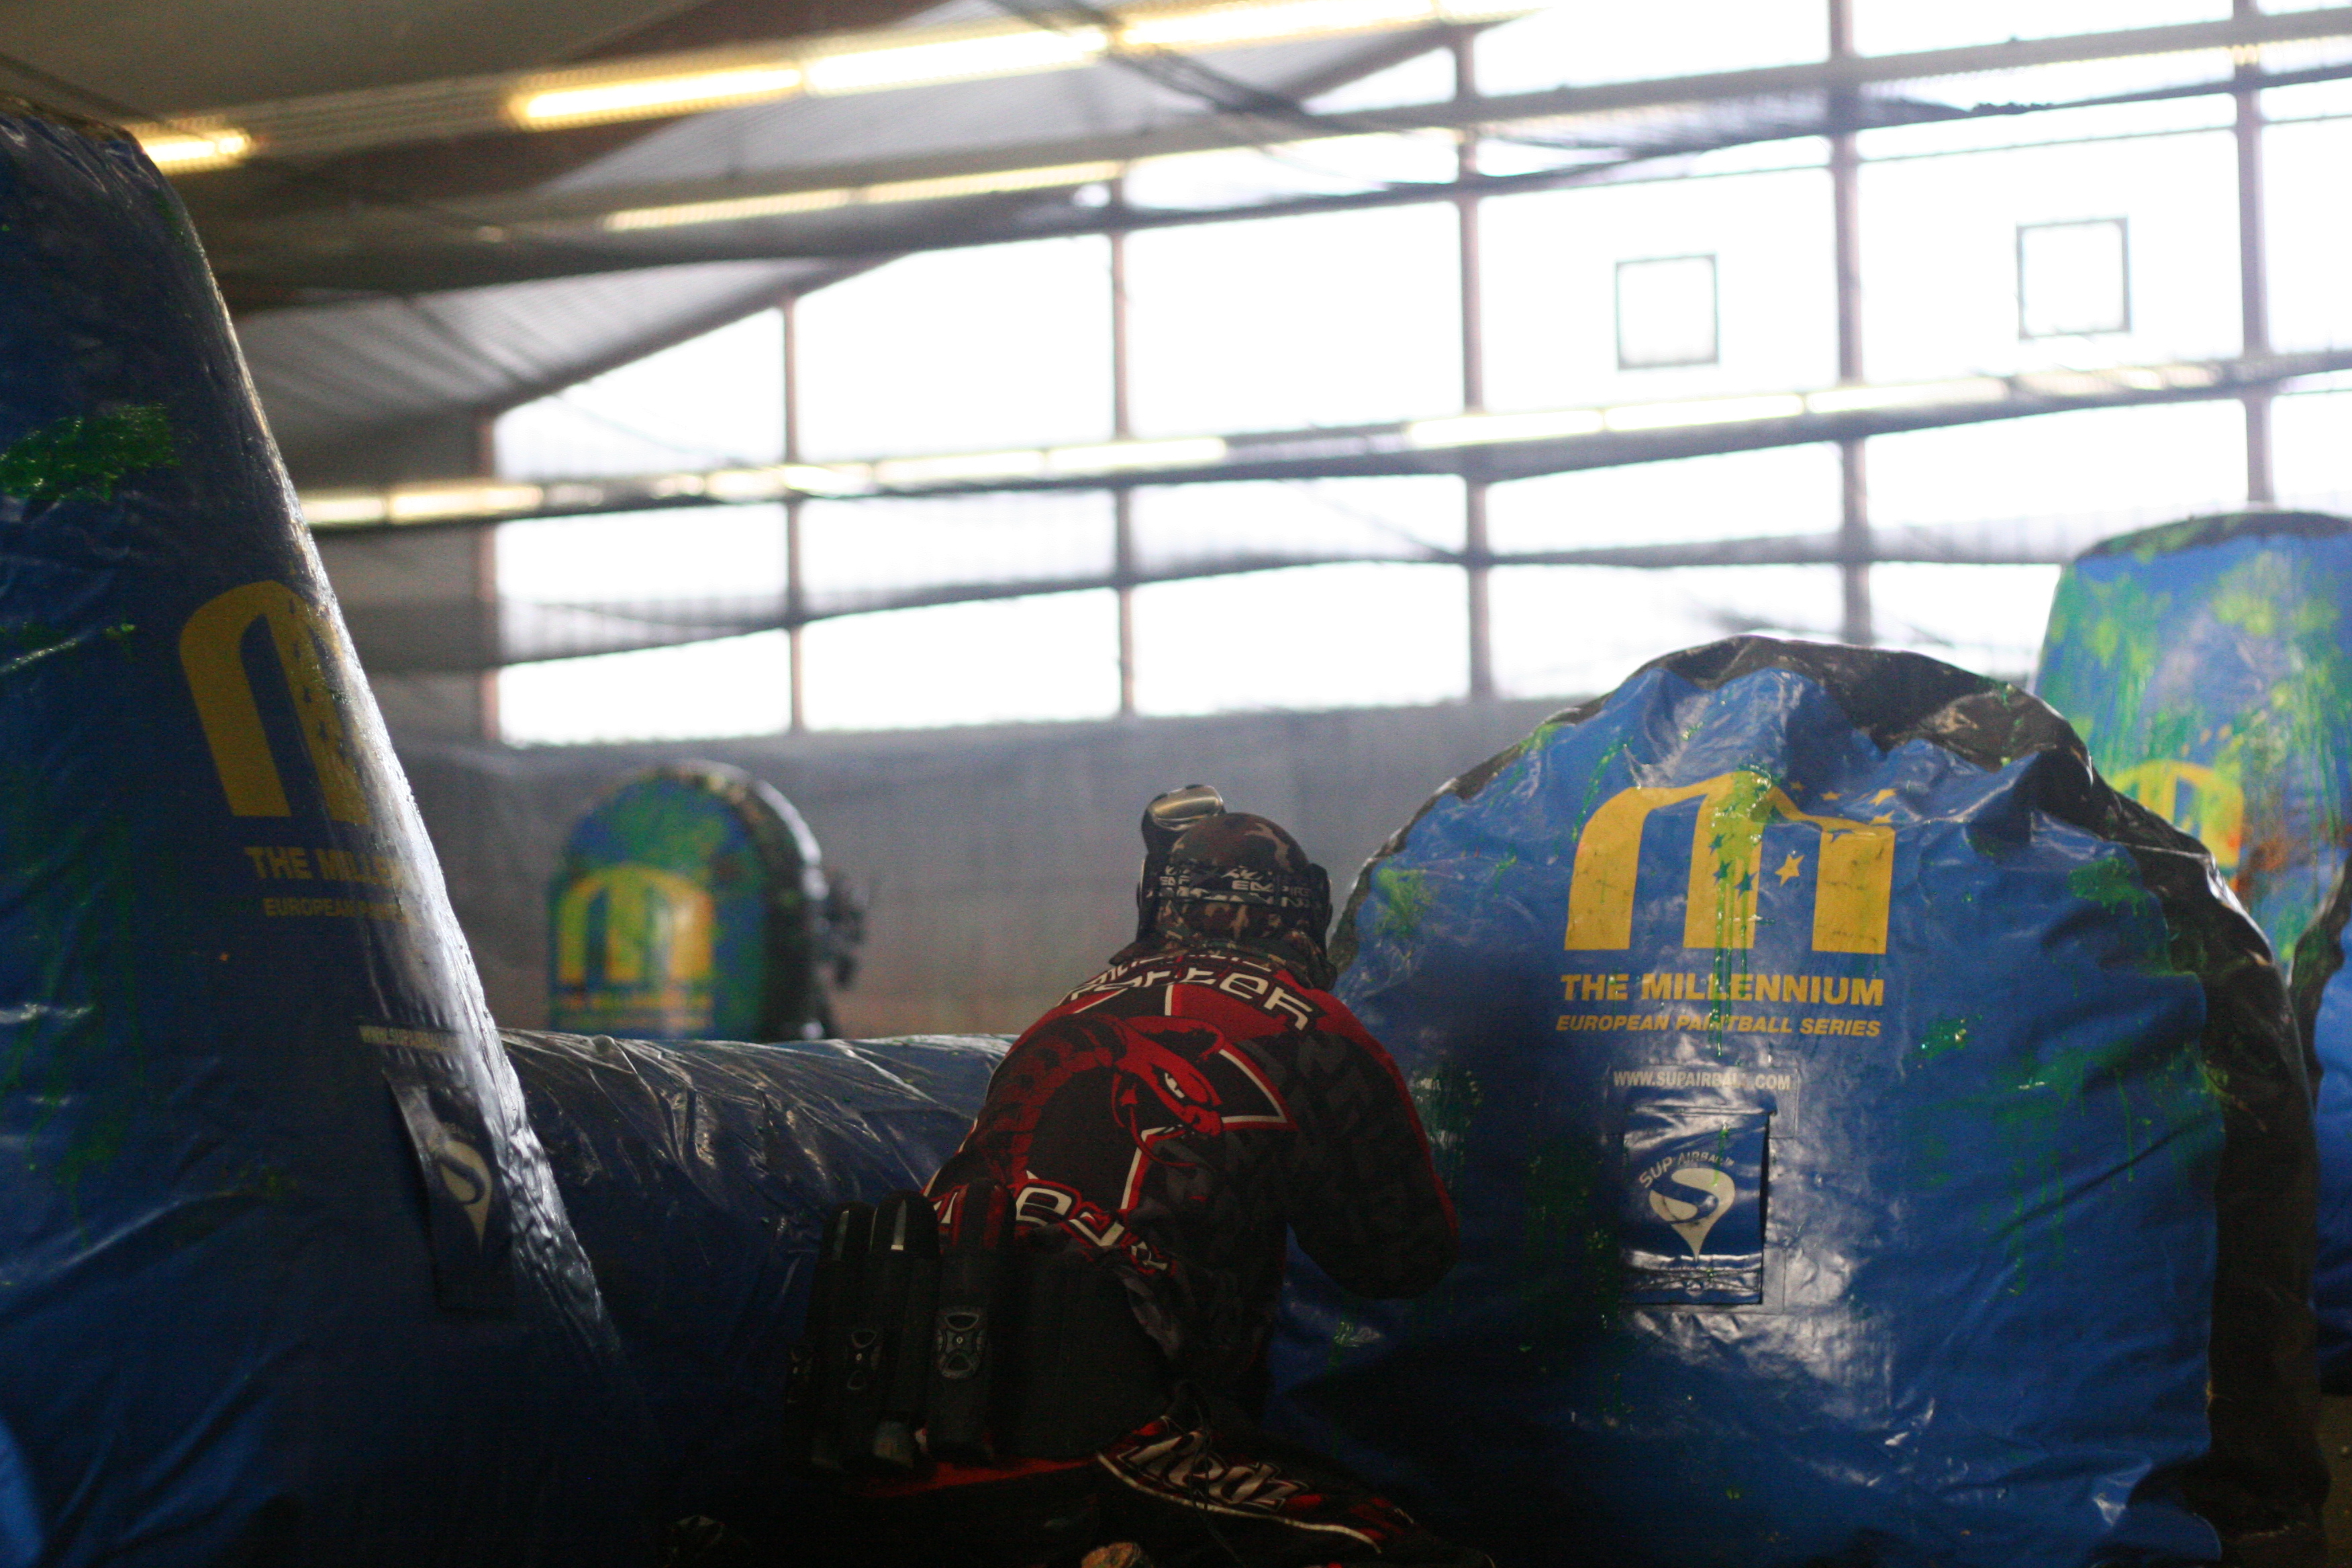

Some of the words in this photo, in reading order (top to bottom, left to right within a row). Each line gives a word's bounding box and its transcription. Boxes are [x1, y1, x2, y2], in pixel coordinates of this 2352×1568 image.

[244, 846, 312, 879] THE
[1561, 973, 1629, 1001] THE
[1641, 973, 1885, 1006] MILLENNIUM
[1555, 1014, 1670, 1032] EUROPEAN
[1675, 1014, 1793, 1034] PAINTBALL
[1799, 1018, 1882, 1037] SERIES
[1638, 1155, 1673, 1189] SUP
